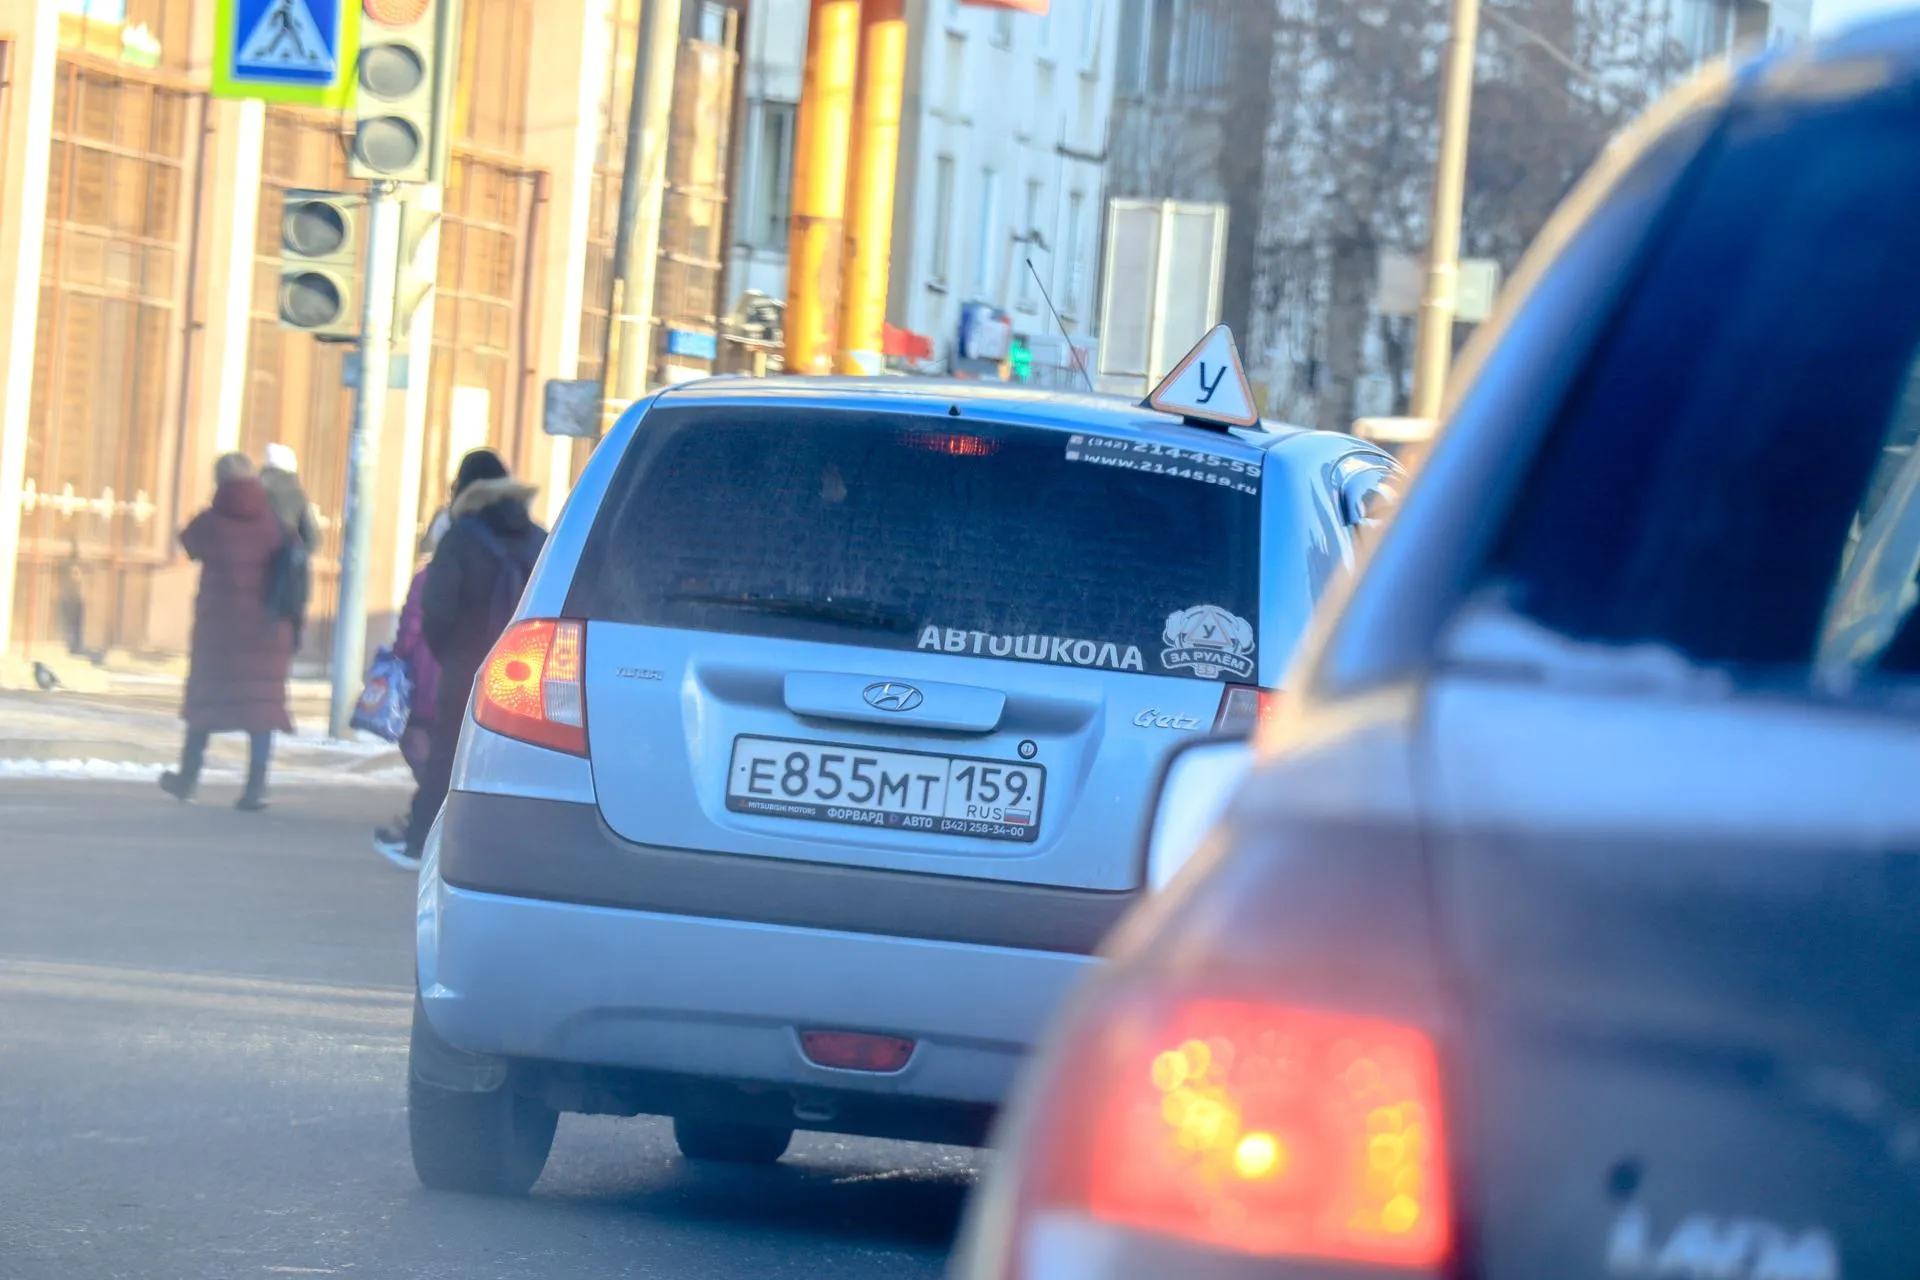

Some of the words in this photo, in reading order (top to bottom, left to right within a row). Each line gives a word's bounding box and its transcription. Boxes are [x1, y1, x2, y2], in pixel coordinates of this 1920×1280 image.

[1196, 361, 1228, 404] У
[1132, 440, 1262, 478] 214-45-59
[1084, 454, 1257, 495] www.2144559.ru
[917, 624, 1145, 671] АВТОШКОЛА
[1170, 651, 1191, 663] ЗА
[1133, 706, 1200, 730] Getz
[955, 765, 1029, 806] 159
[748, 801, 787, 812] MITSUBISHI
[787, 805, 816, 815] MOTORS
[827, 807, 884, 825] ФОРВАРД
[902, 815, 933, 828] АВТО
[966, 804, 1002, 820] RUS
[941, 819, 967, 832] (342)
[969, 822, 1024, 837] 258-34-00
